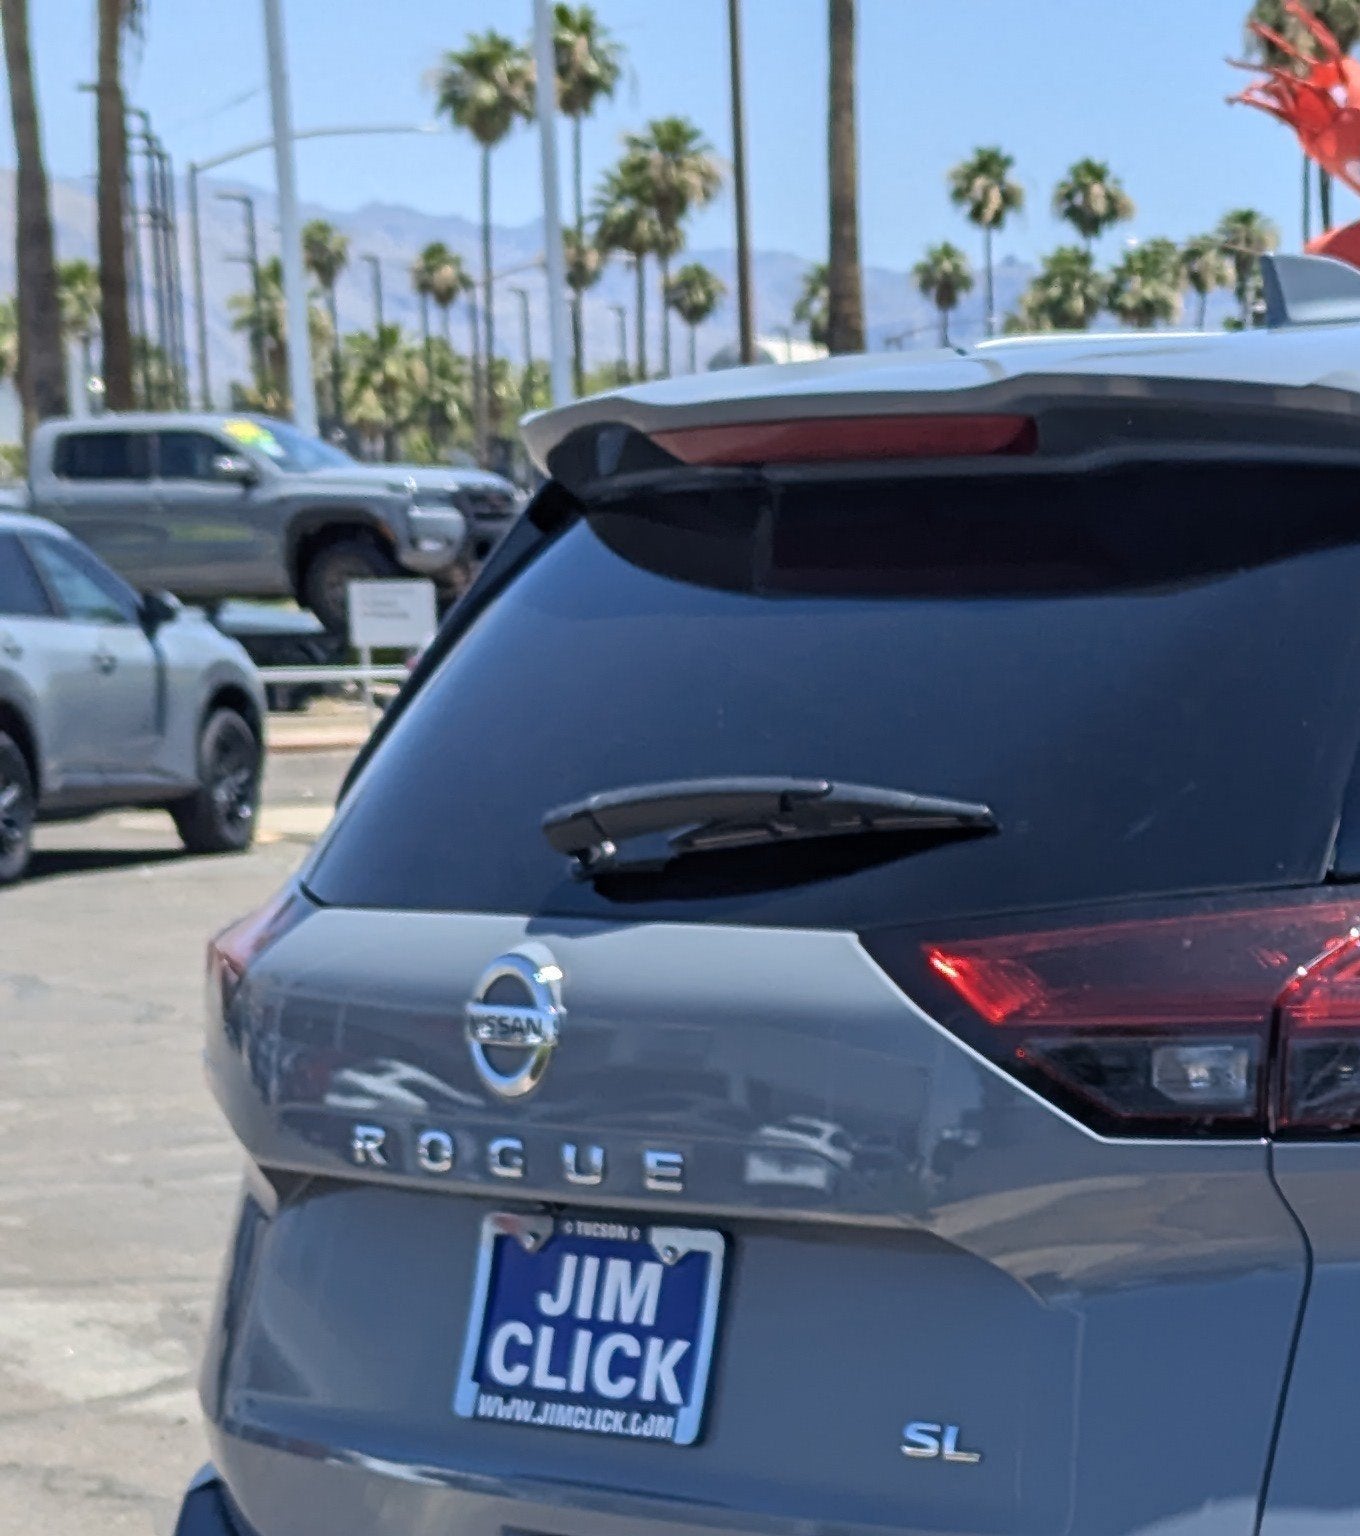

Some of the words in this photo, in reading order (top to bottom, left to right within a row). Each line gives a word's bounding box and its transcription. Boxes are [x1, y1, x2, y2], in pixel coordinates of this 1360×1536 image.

[352, 1123, 684, 1193] ROGUE
[575, 1219, 629, 1240] TUCSON
[537, 1253, 664, 1327] JIM
[487, 1320, 691, 1405] CLICK
[477, 1393, 675, 1439] WWW.JIMCLICK.COM
[901, 1421, 981, 1463] SL
